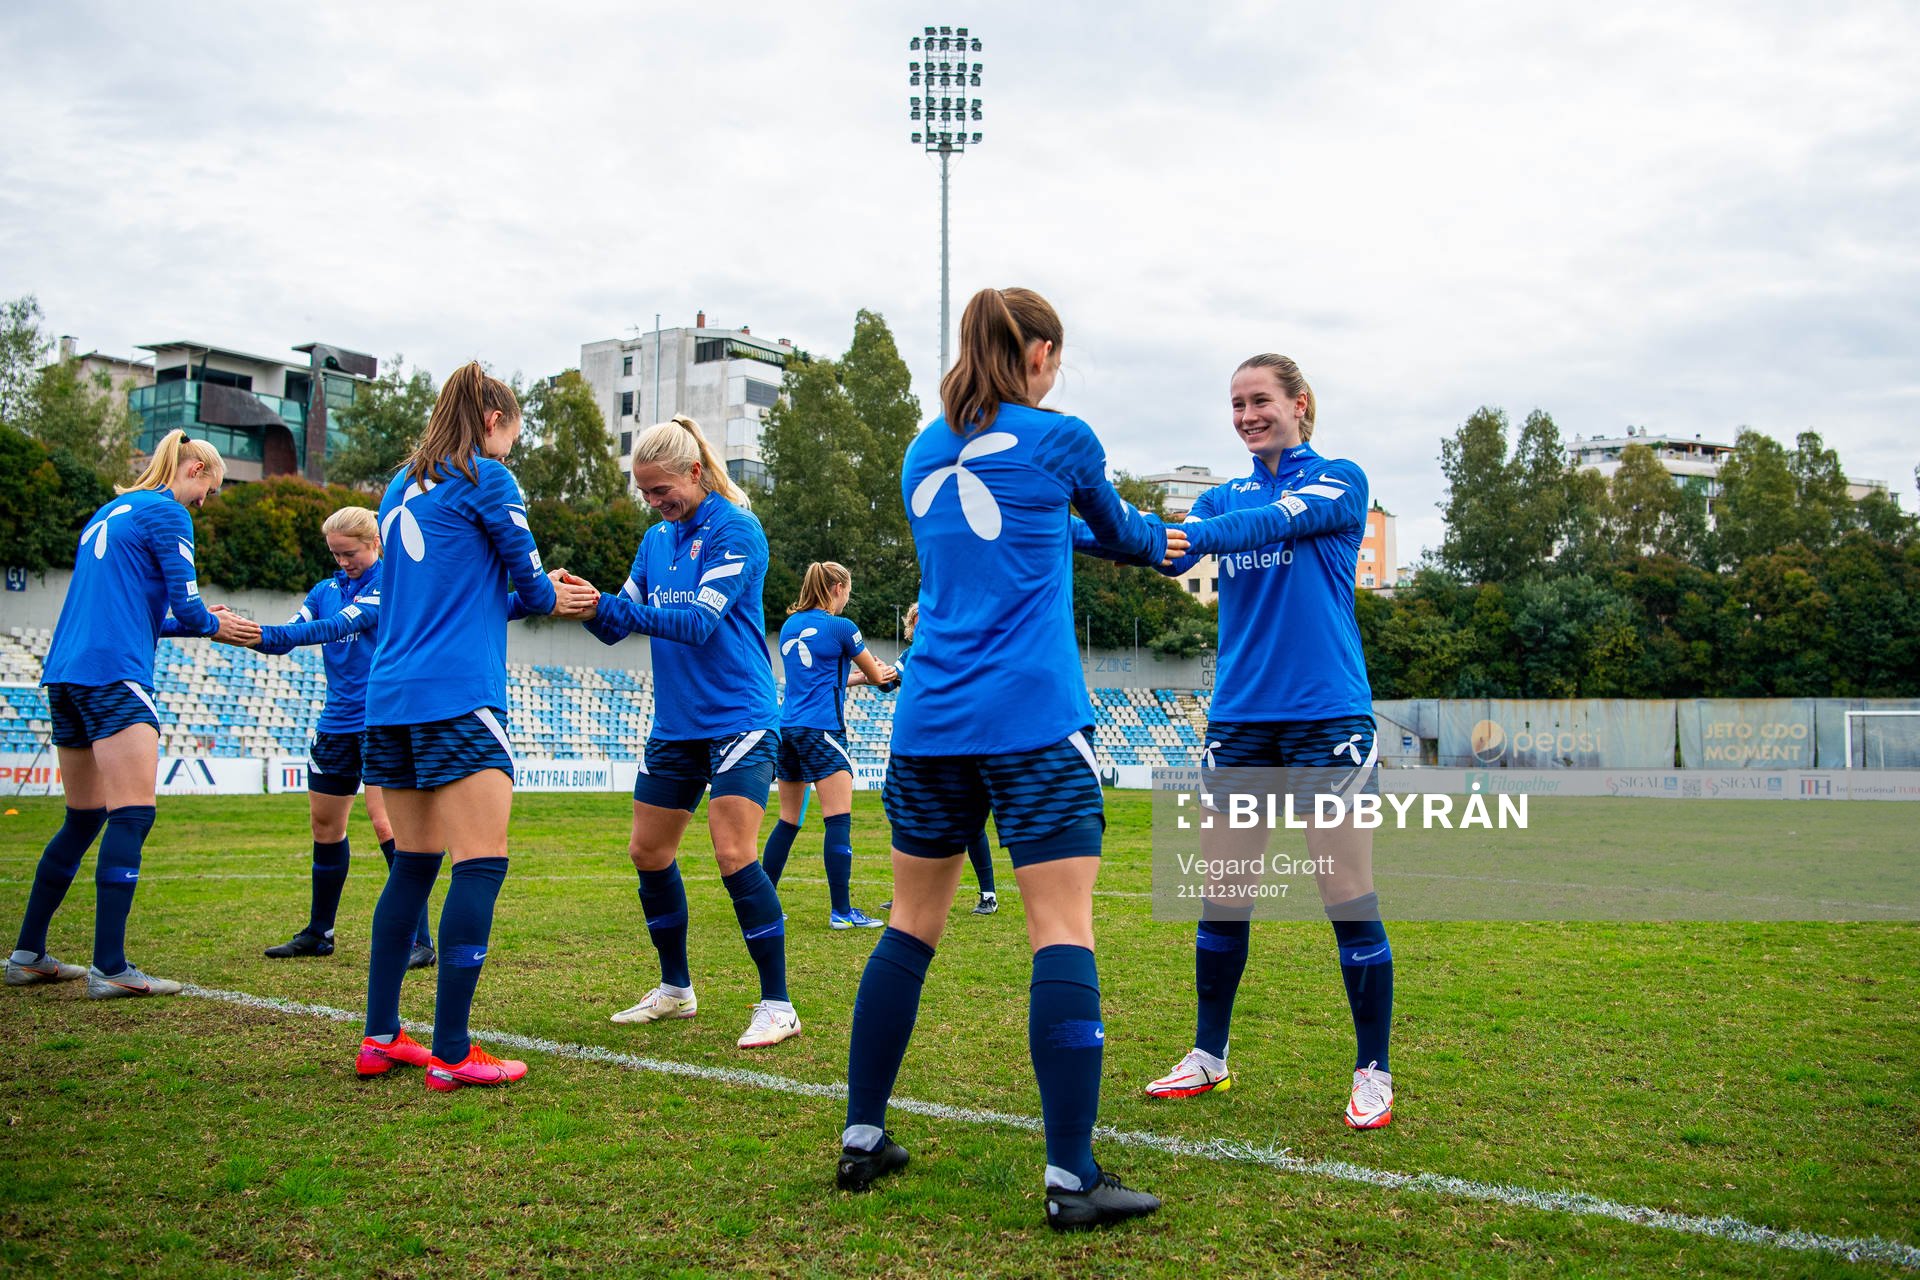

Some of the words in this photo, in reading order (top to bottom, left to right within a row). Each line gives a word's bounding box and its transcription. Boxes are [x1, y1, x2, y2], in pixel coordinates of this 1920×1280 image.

[1235, 549, 1294, 571] teleno
[8, 566, 24, 582] G1
[660, 588, 695, 604] teleno
[701, 590, 724, 607] DNB
[1704, 722, 1752, 740] JETO
[1760, 722, 1809, 740] CDO
[1513, 728, 1601, 759] pepsi
[1704, 744, 1801, 762] MOMENT
[526, 769, 570, 787] NATYRAL
[571, 769, 608, 787] BURIMI
[1620, 775, 1662, 789] SIGAL
[1720, 776, 1767, 790] SIGAL
[1836, 784, 1897, 794] Intrnational
